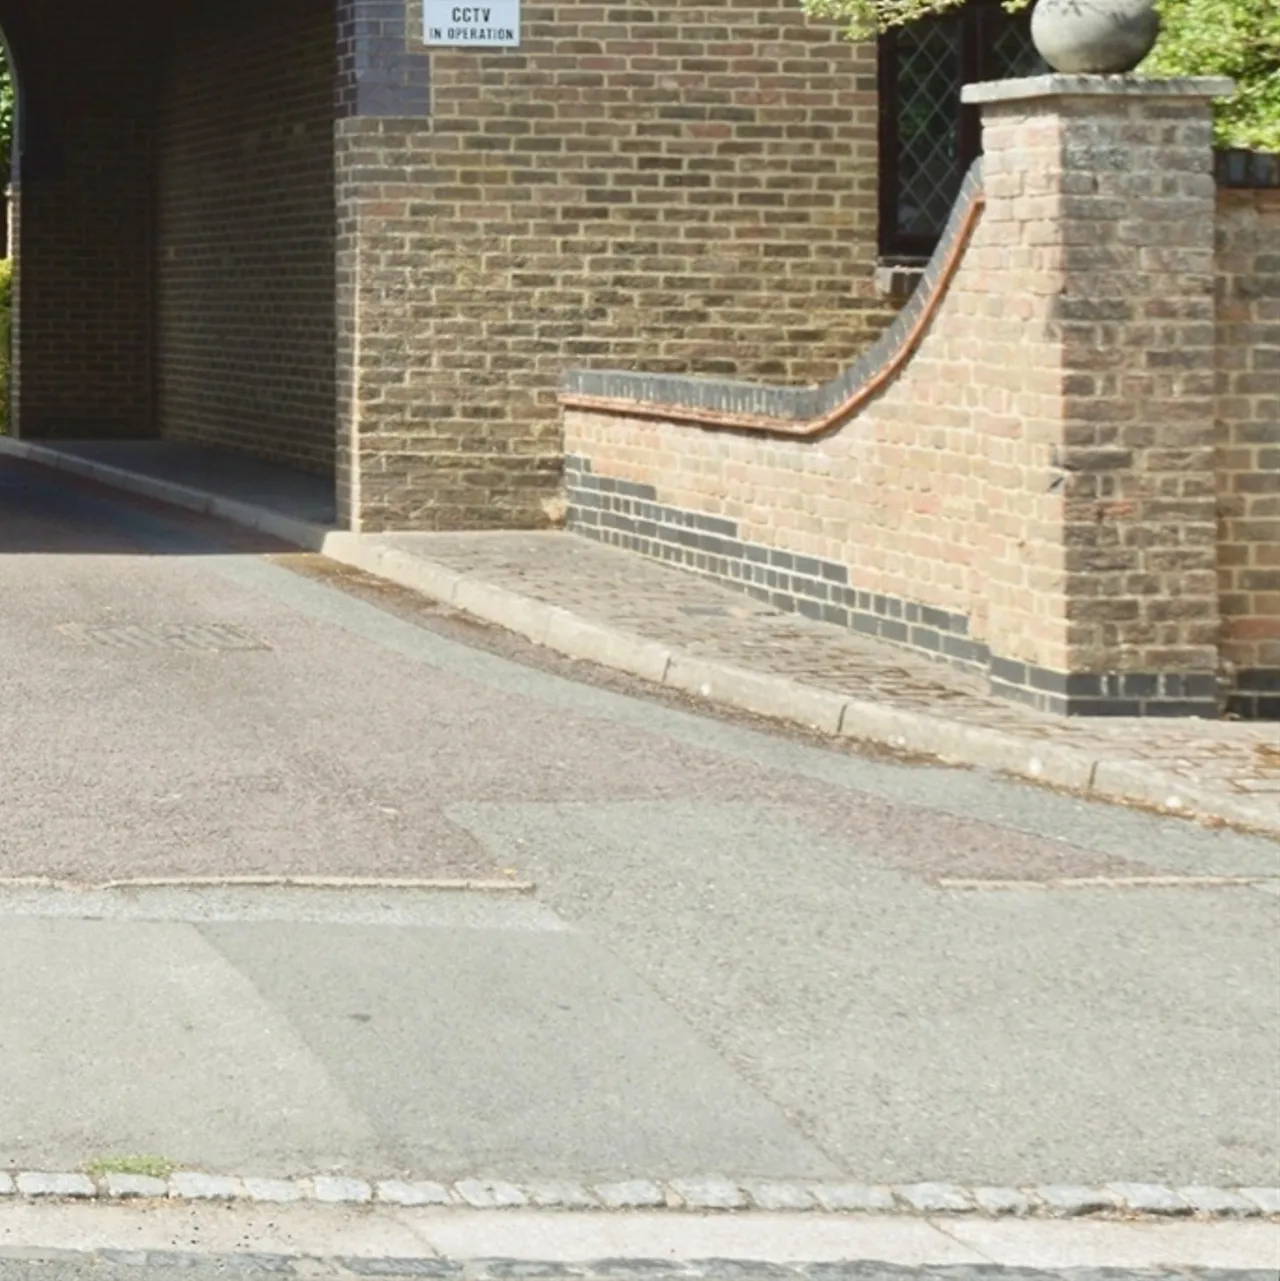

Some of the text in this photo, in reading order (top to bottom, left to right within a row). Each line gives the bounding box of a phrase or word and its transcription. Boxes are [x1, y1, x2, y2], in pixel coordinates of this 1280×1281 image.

[452, 6, 491, 23] CCTV
[429, 27, 514, 41] IN OPERATION
